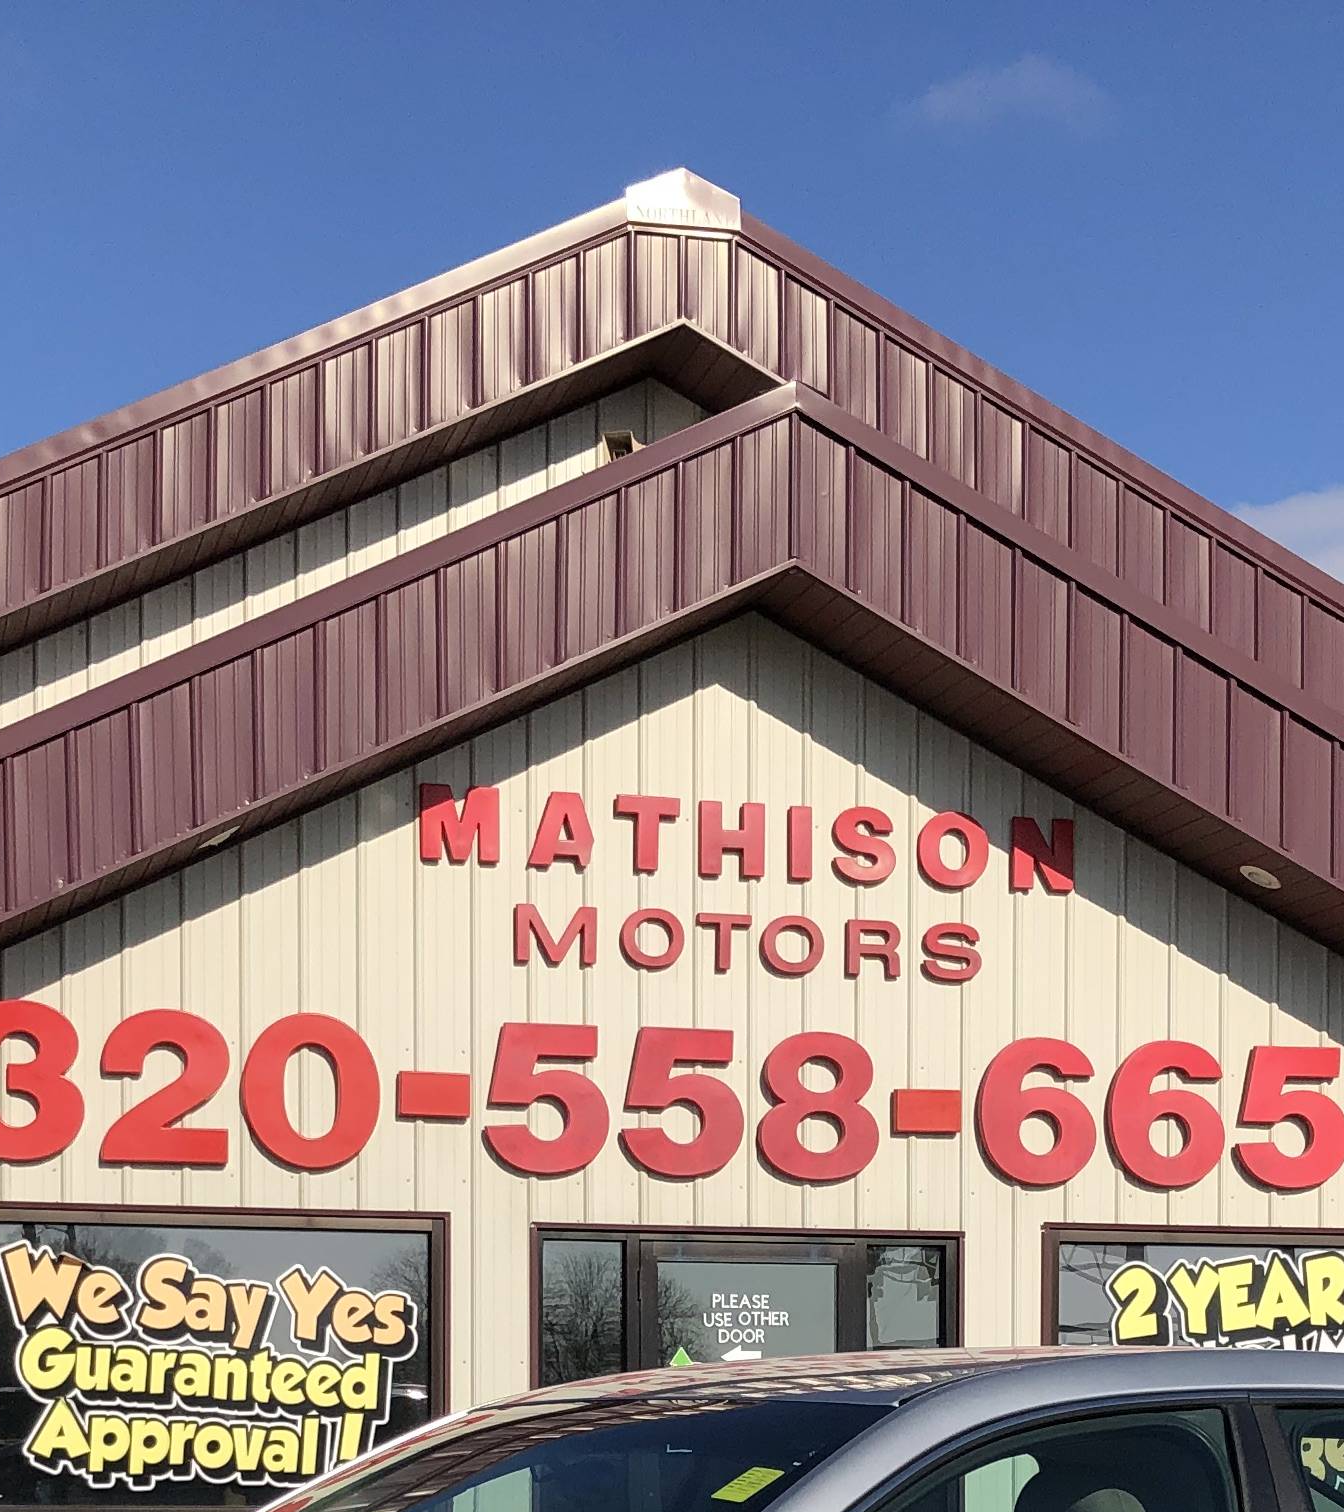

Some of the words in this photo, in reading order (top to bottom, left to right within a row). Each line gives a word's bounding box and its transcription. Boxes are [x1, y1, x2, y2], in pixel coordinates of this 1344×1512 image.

[419, 783, 1076, 894] MATHISON
[513, 903, 983, 984] MOTORS
[0, 1242, 124, 1325] We
[137, 1255, 270, 1351] Say
[279, 1267, 408, 1347] Yes
[703, 1312, 733, 1327] USE
[738, 1311, 789, 1326] OTHER
[712, 1293, 770, 1309] PLEASE
[718, 1328, 765, 1343] DOOR
[1109, 1264, 1160, 1342] 2
[18, 1324, 382, 1412] Guaranteed
